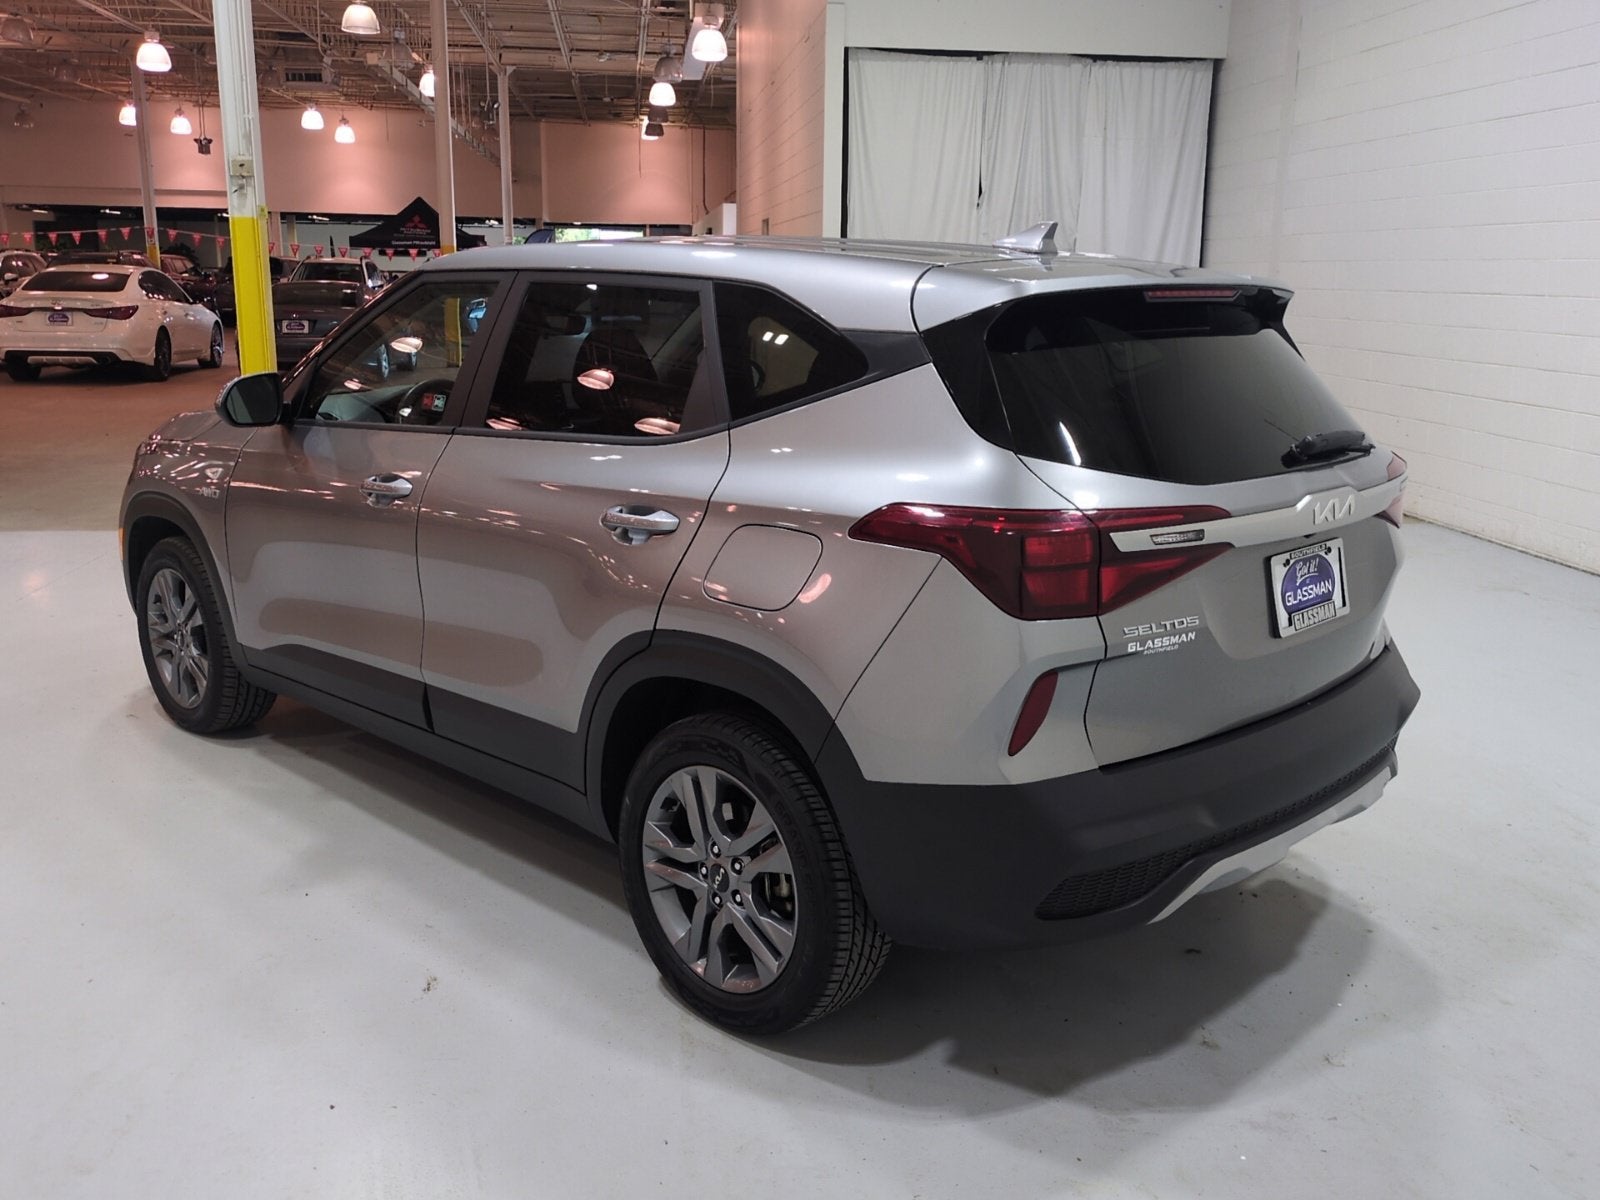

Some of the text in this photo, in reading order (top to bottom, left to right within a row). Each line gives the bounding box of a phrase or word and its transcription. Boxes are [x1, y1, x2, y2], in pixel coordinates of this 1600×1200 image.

[1312, 495, 1354, 525] KIA
[1285, 579, 1333, 606] GLASSMAN
[1122, 615, 1200, 639] SELTOS
[1293, 602, 1336, 630] GLASSMAN
[1127, 631, 1196, 653] GLASSMAN
